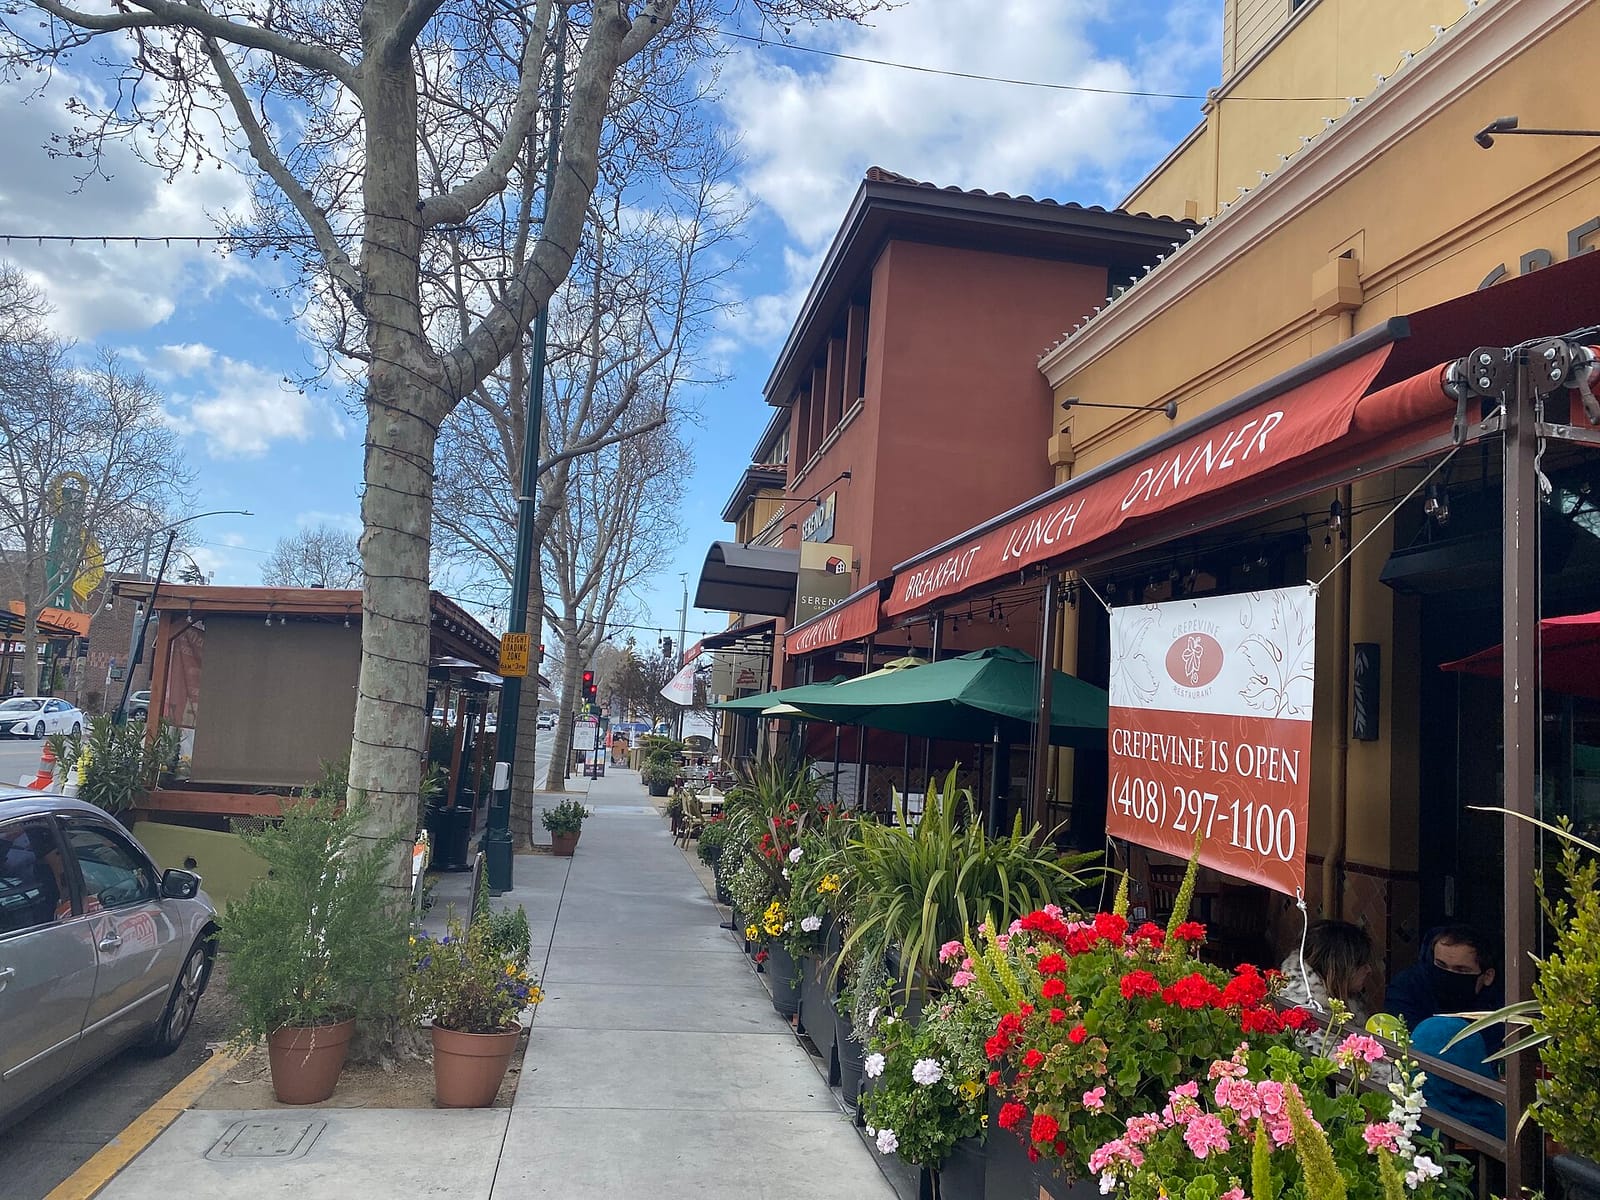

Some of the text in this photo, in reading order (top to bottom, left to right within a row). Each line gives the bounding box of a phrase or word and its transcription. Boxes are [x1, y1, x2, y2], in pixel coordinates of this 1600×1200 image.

[905, 411, 1284, 601] BREAKFAST LUNCH DINNER
[796, 613, 841, 650] CREPEVINE
[1171, 617, 1220, 639] CREPEVINE
[502, 644, 527, 652] LOADING
[507, 652, 521, 660] ZONE
[1173, 685, 1213, 700] RESTAURANT
[1112, 728, 1300, 784] CREPEVINE IS OPEN
[1111, 772, 1296, 862] (408) 297-1100
